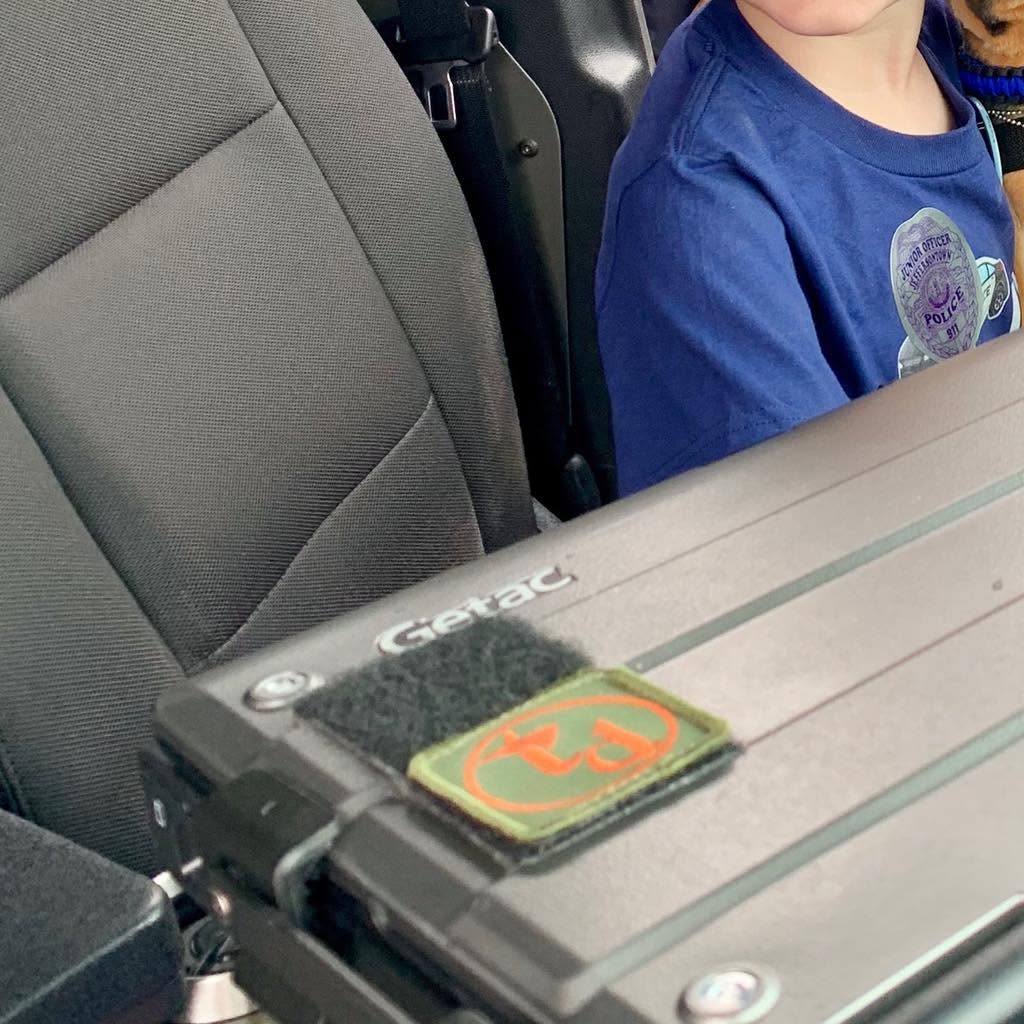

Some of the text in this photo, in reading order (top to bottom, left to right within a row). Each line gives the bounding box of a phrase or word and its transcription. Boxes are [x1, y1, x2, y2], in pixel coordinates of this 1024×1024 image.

[901, 233, 952, 281] JUNIOR OFFICER
[924, 286, 964, 326] POLICE
[376, 565, 577, 657] Getac
